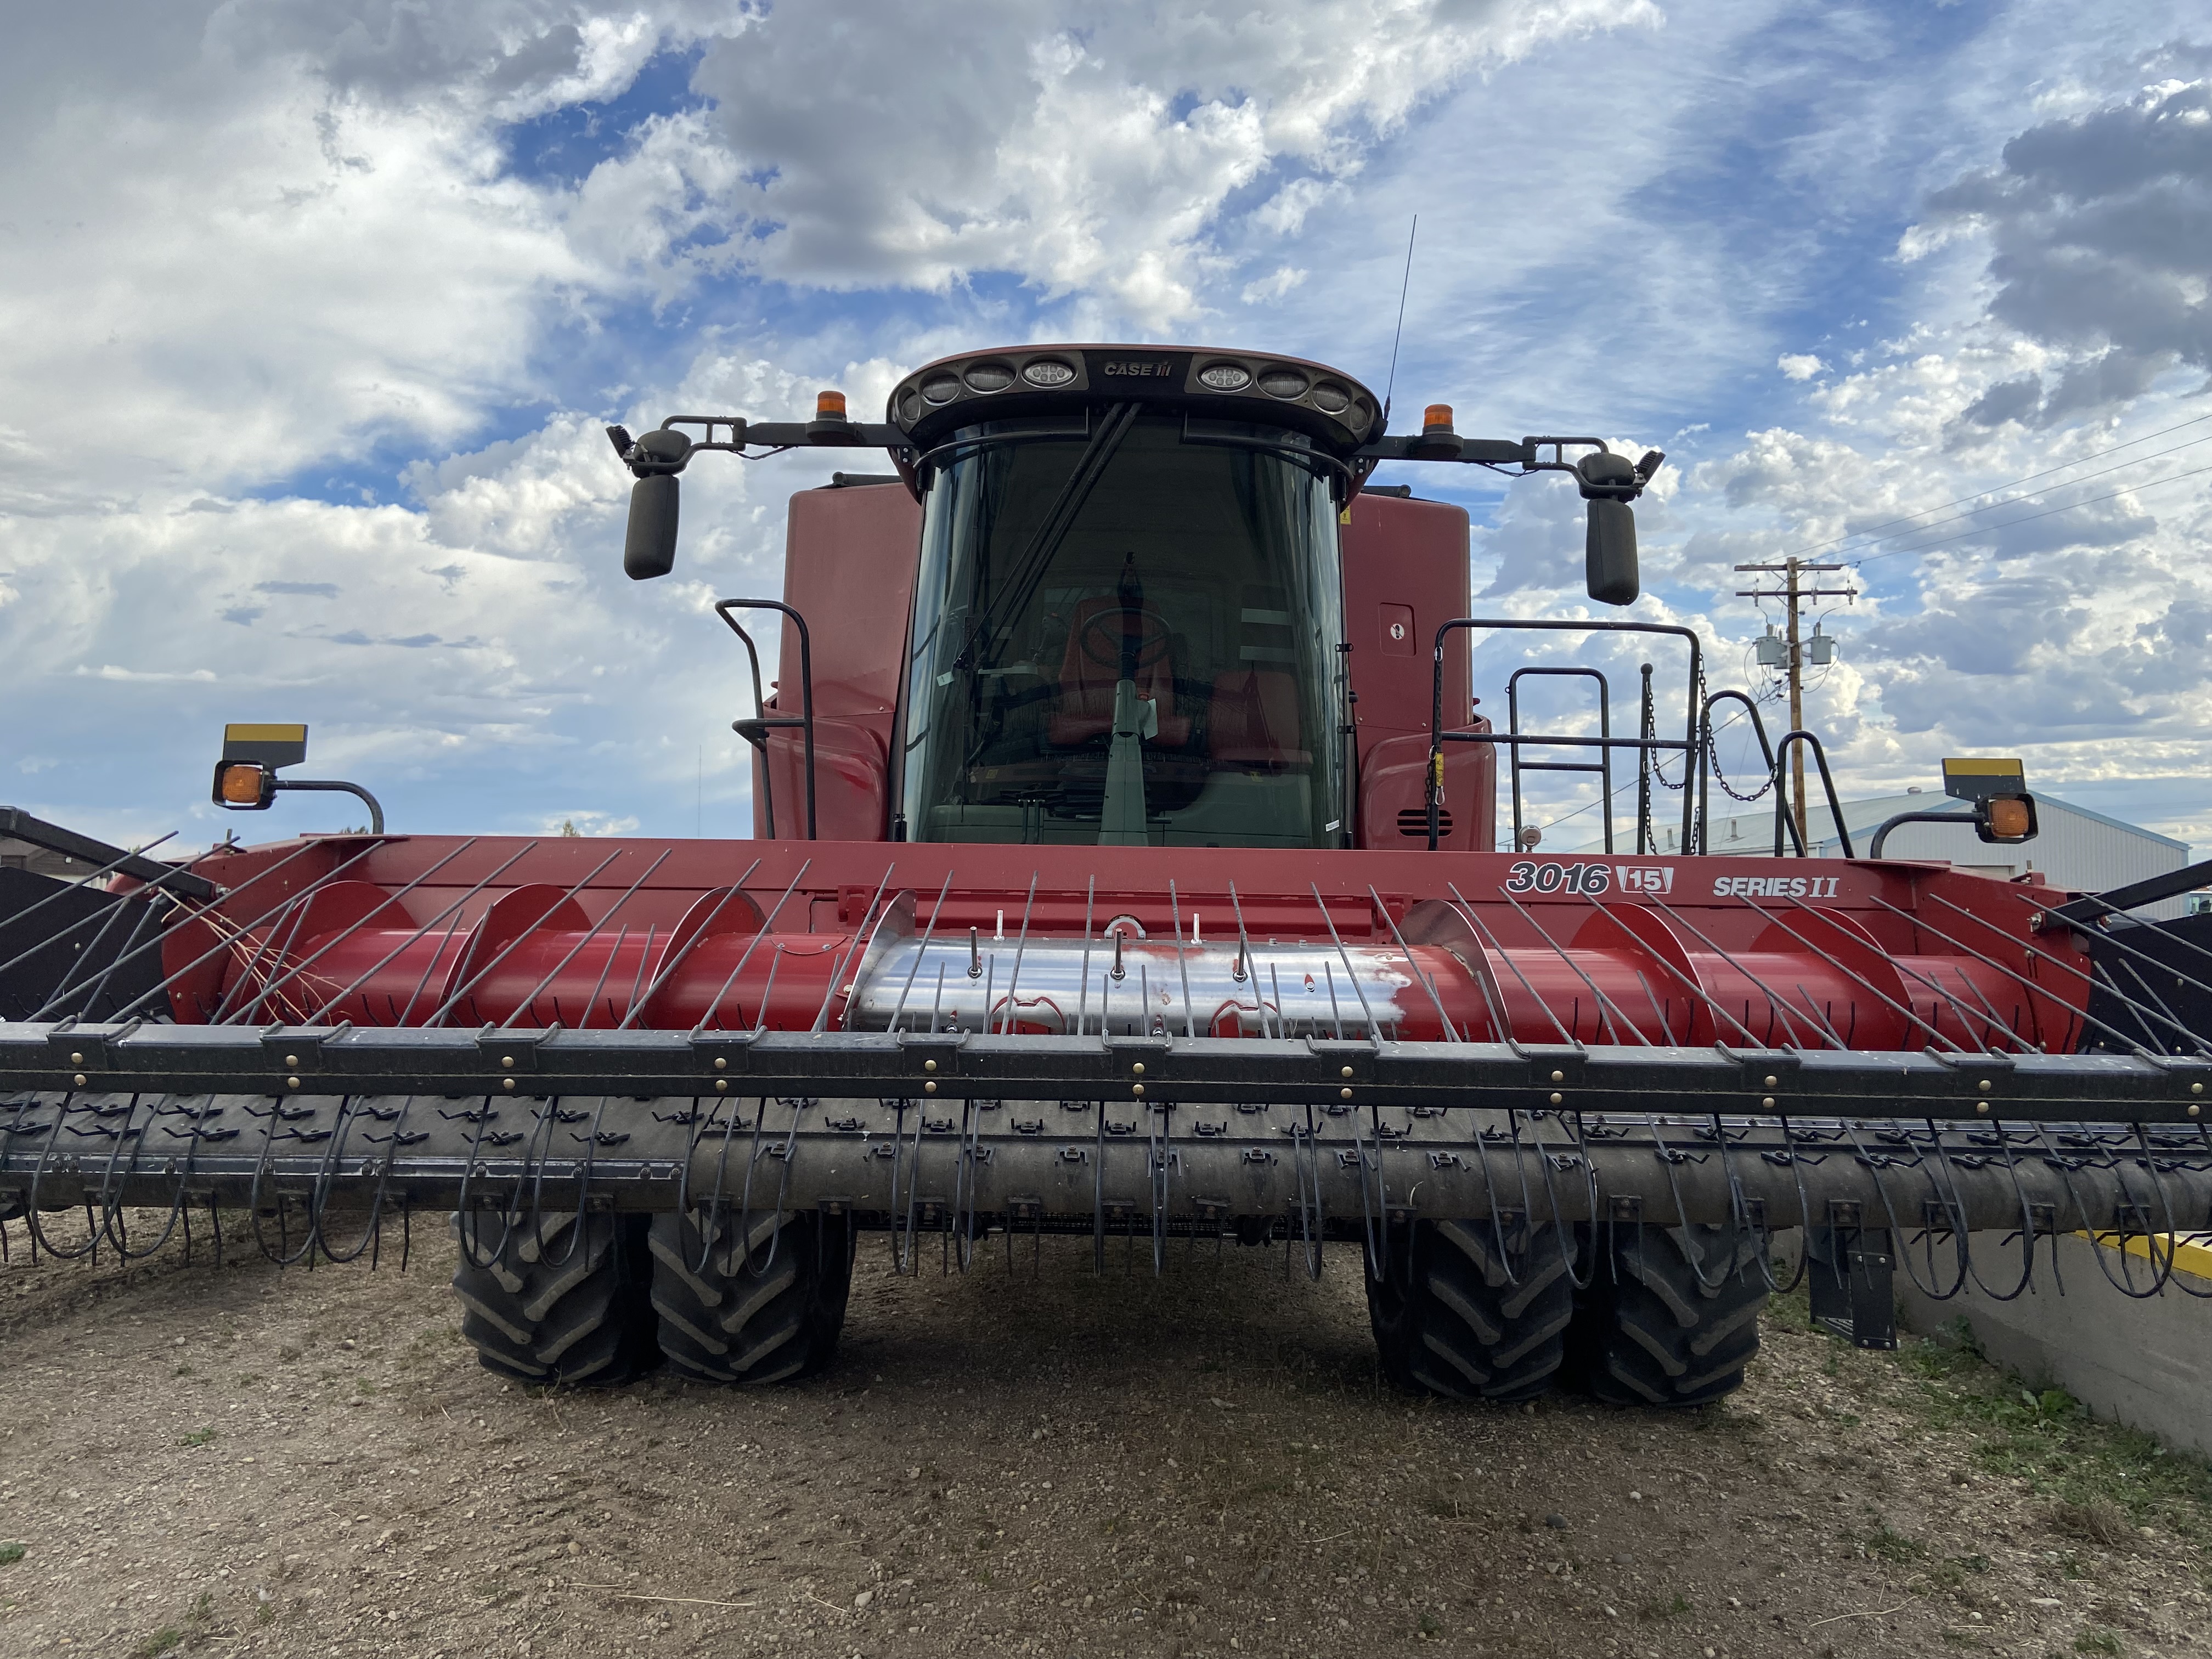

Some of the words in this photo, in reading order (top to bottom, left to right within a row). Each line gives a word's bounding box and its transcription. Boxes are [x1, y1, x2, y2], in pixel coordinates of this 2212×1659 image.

[1104, 363, 1153, 376] CASE
[1506, 861, 1611, 895] 3016
[1629, 870, 1662, 891] 15
[1712, 877, 1807, 898] SERIES
[1808, 877, 1839, 898] II
